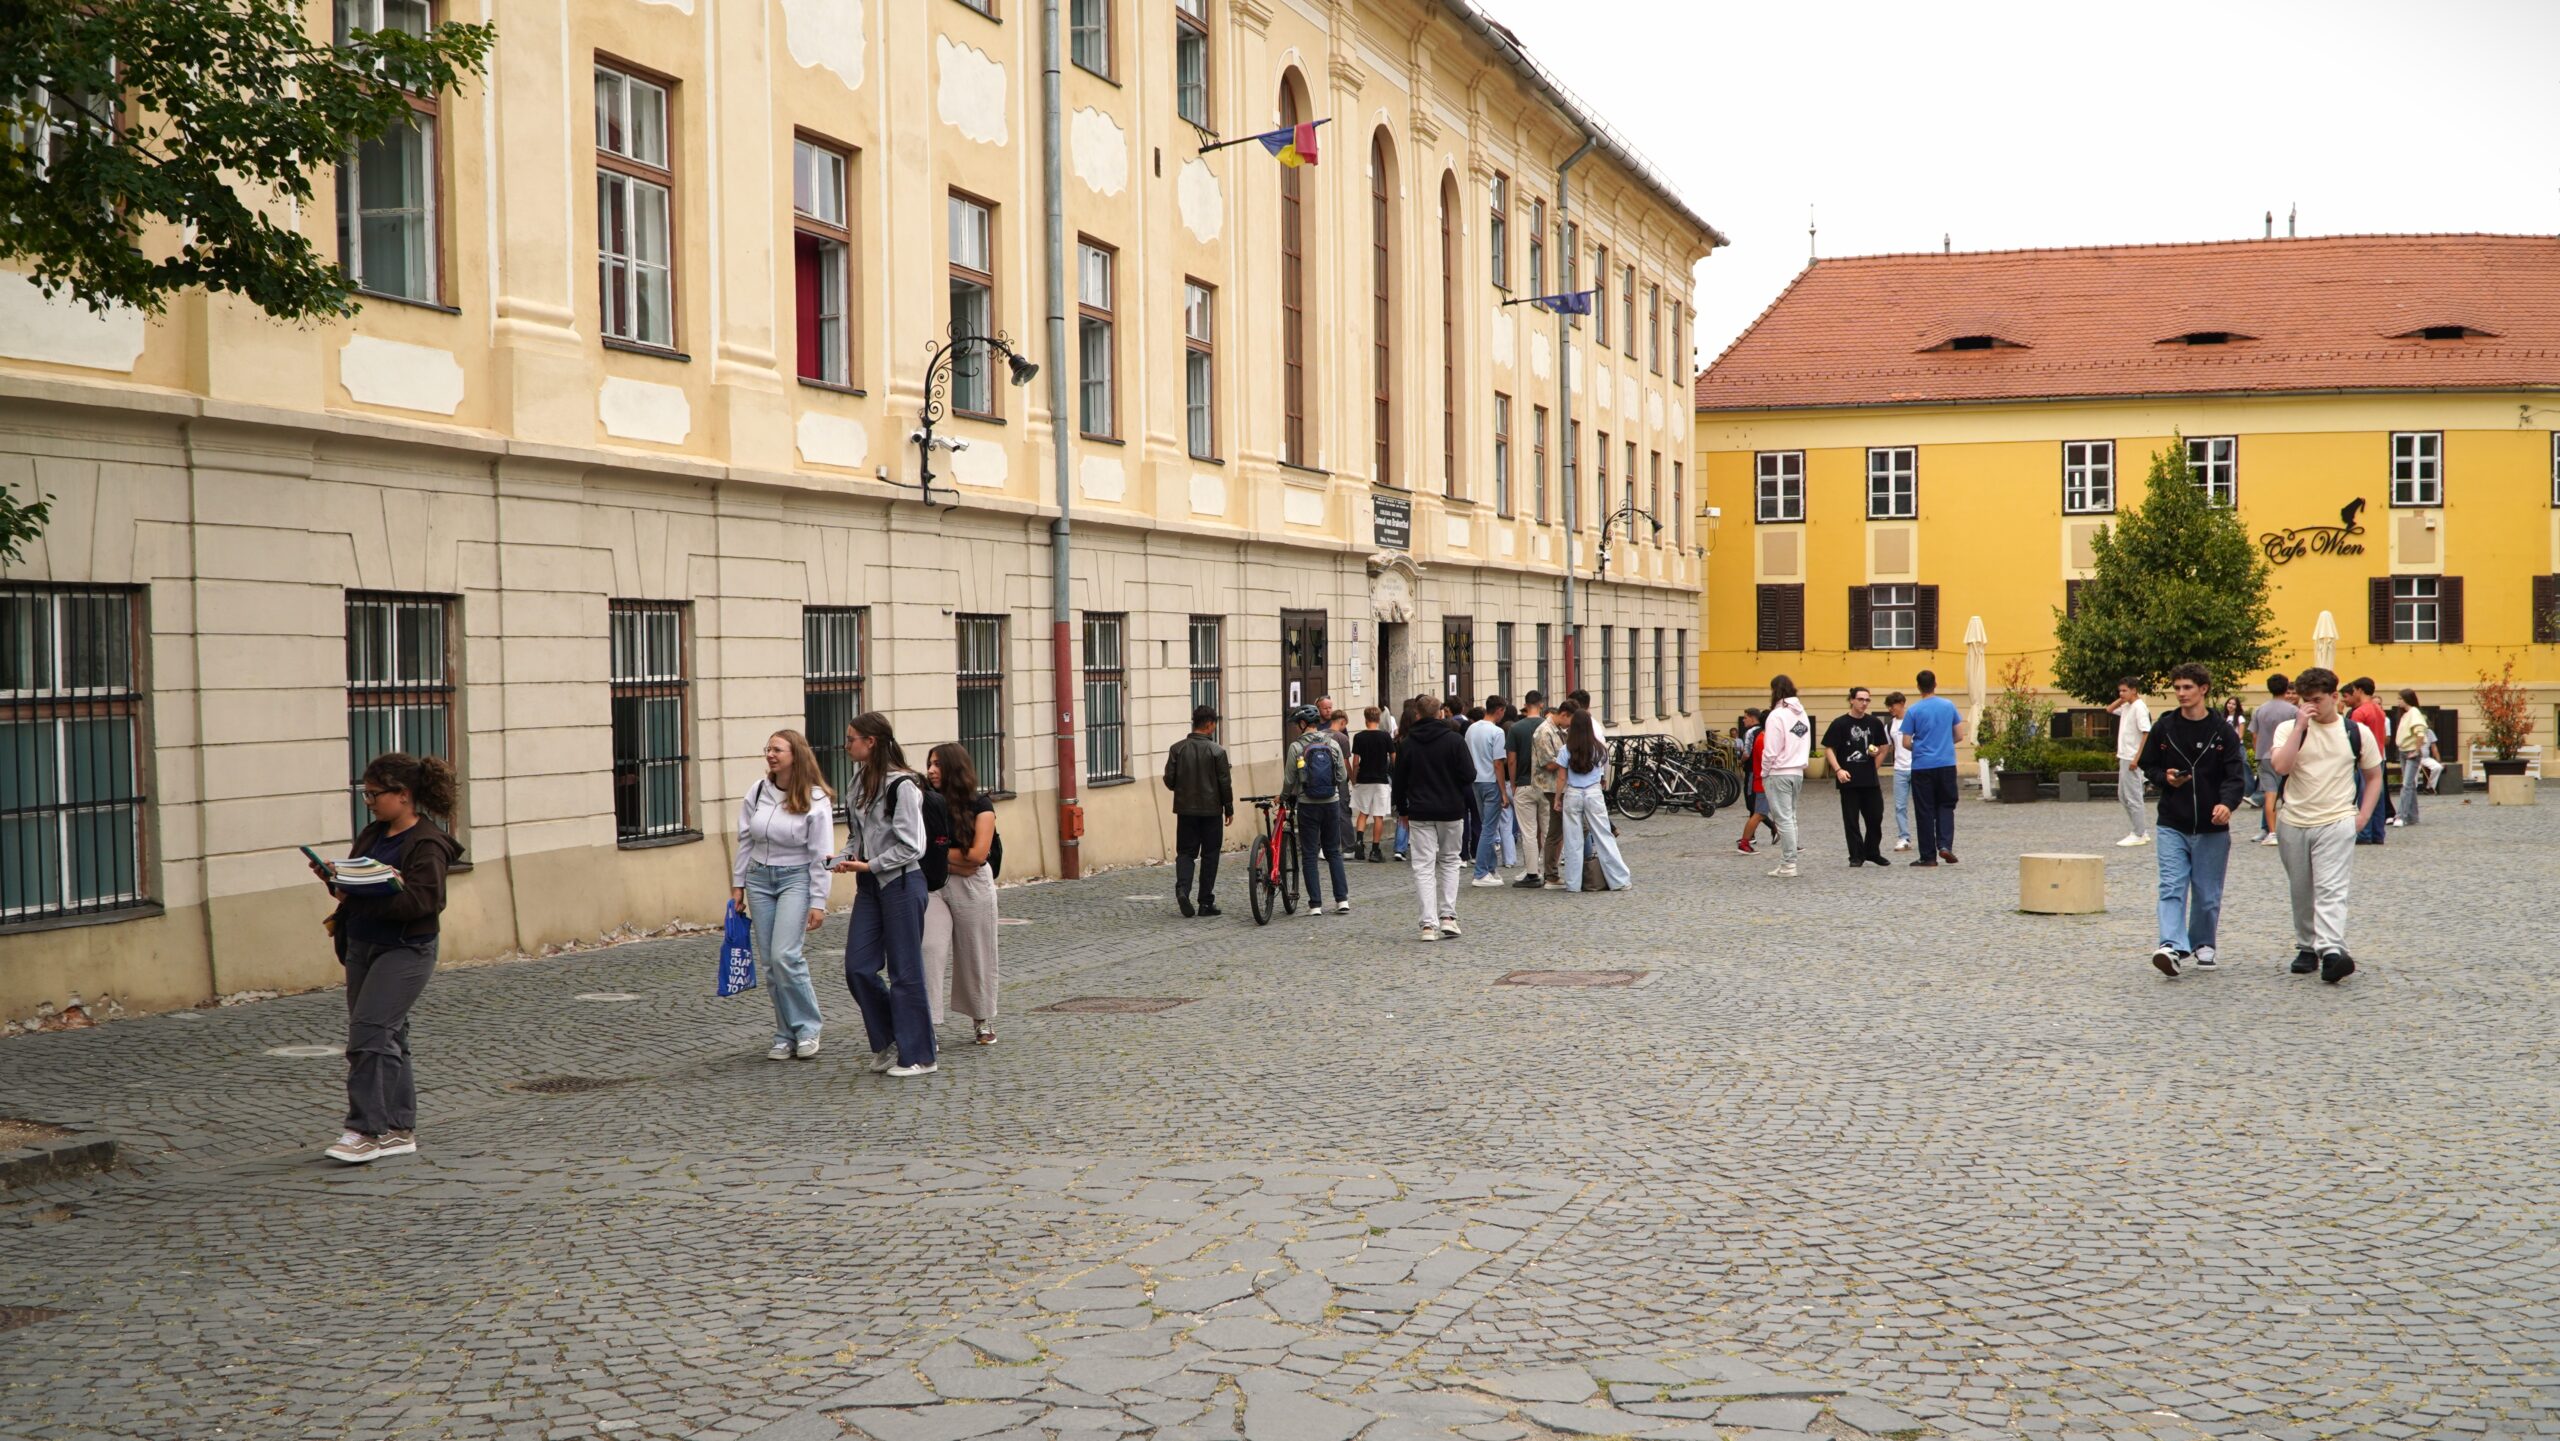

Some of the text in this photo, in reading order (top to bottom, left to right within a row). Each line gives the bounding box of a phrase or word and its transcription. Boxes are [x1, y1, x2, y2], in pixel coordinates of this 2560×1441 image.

[2311, 529, 2365, 556] Wien
[731, 948, 742, 957] BE
[730, 966, 748, 976] YOU
[727, 984, 738, 993] TO
